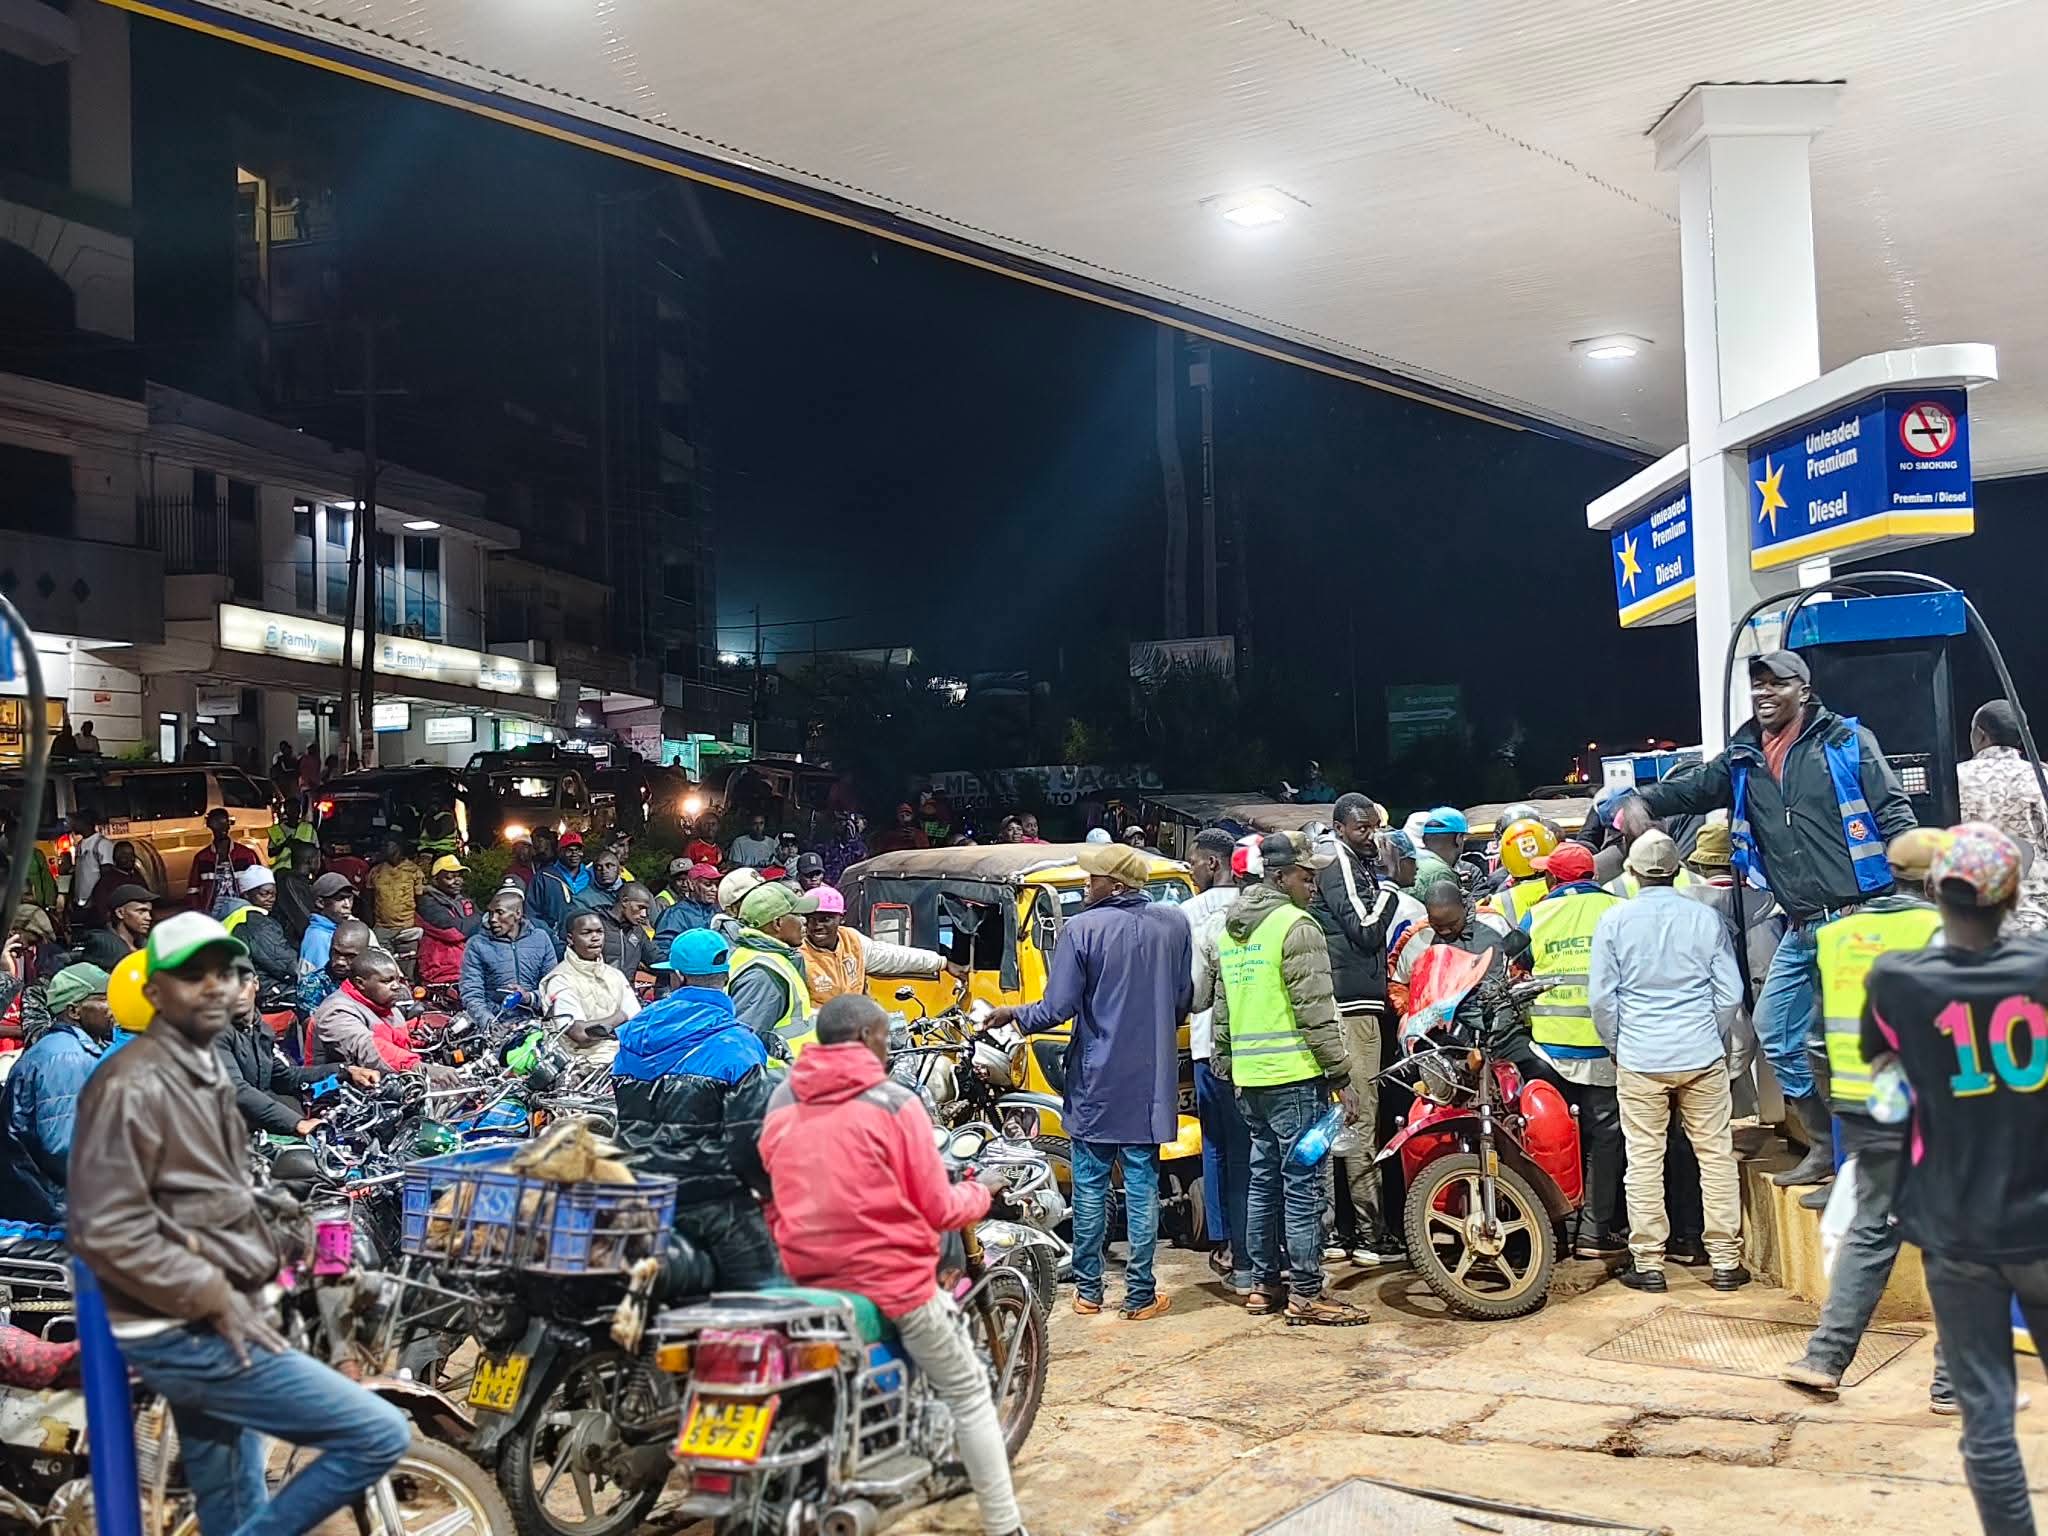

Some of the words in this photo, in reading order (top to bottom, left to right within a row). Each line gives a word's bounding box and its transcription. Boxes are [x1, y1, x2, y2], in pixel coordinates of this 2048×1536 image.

[1806, 416, 1860, 454] Unleaded
[1807, 447, 1858, 480] Premium
[1899, 462, 1914, 471] NO
[1915, 460, 1958, 470] SMOKING
[1650, 495, 1687, 529] Unleaded
[1808, 490, 1848, 525] Diesel
[1893, 493, 1933, 504] Premium
[1938, 491, 1967, 503] Diesel
[1651, 519, 1687, 549] Premium
[1655, 555, 1682, 586] Diesel
[280, 630, 318, 652] Family
[396, 650, 428, 671] Family
[1934, 994, 2048, 1098] 10
